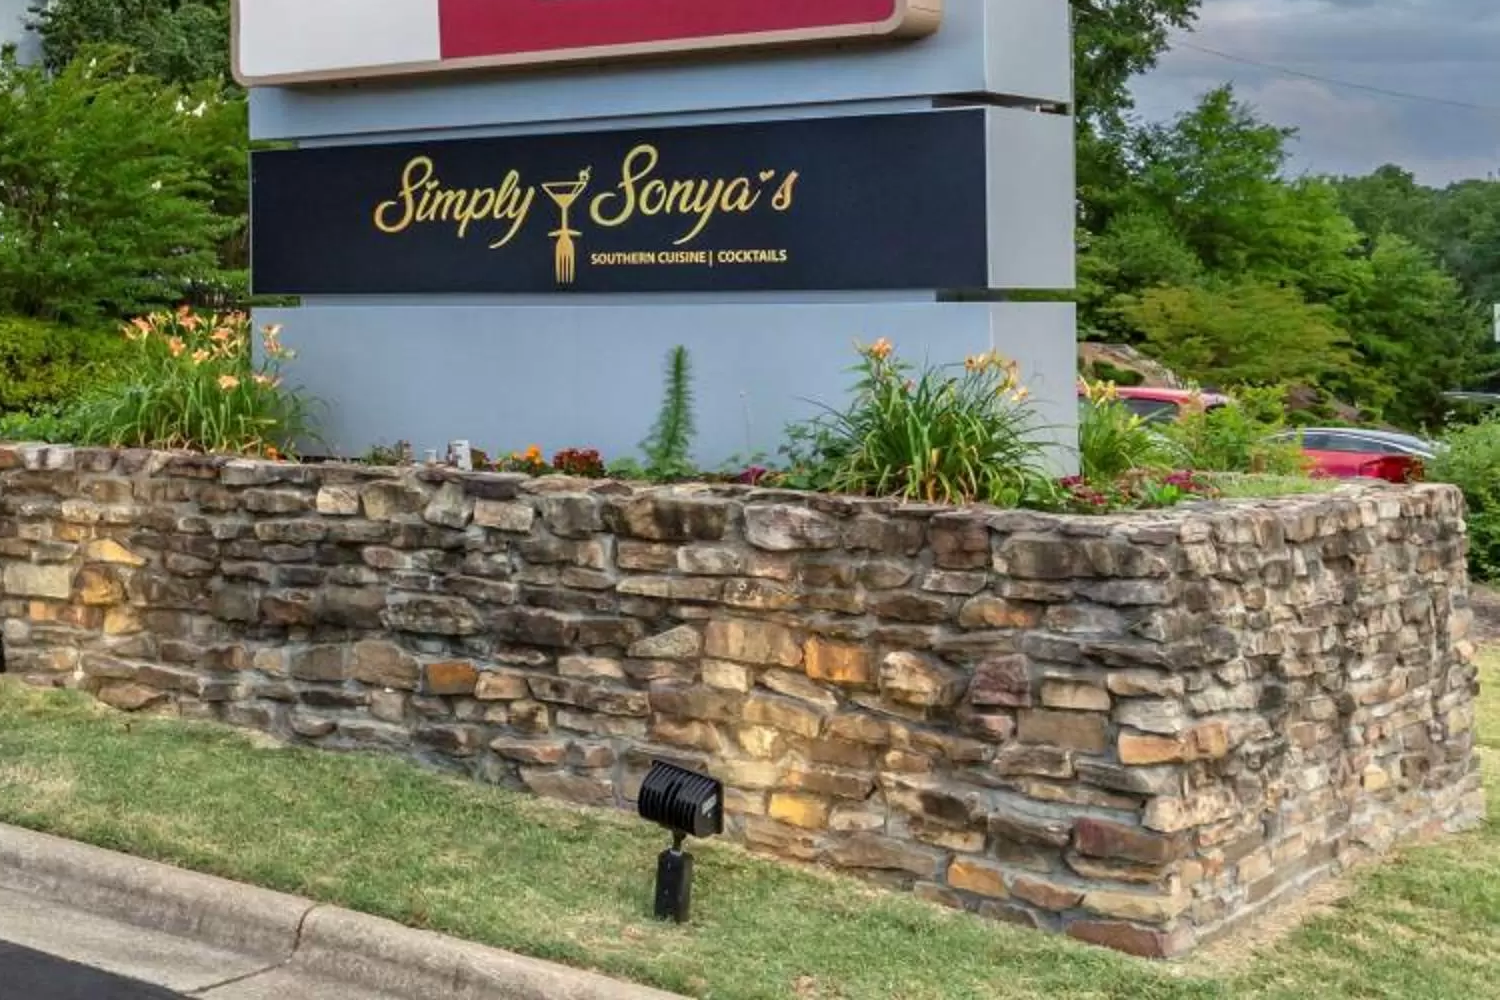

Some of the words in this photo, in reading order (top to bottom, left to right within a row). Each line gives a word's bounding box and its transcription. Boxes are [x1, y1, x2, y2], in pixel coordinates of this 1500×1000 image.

[374, 155, 536, 249] Simply
[589, 143, 799, 245] Sonya's
[590, 252, 654, 265] SOUTHERN
[657, 251, 706, 264] CUISINE
[717, 249, 787, 263] COCKTAILS
